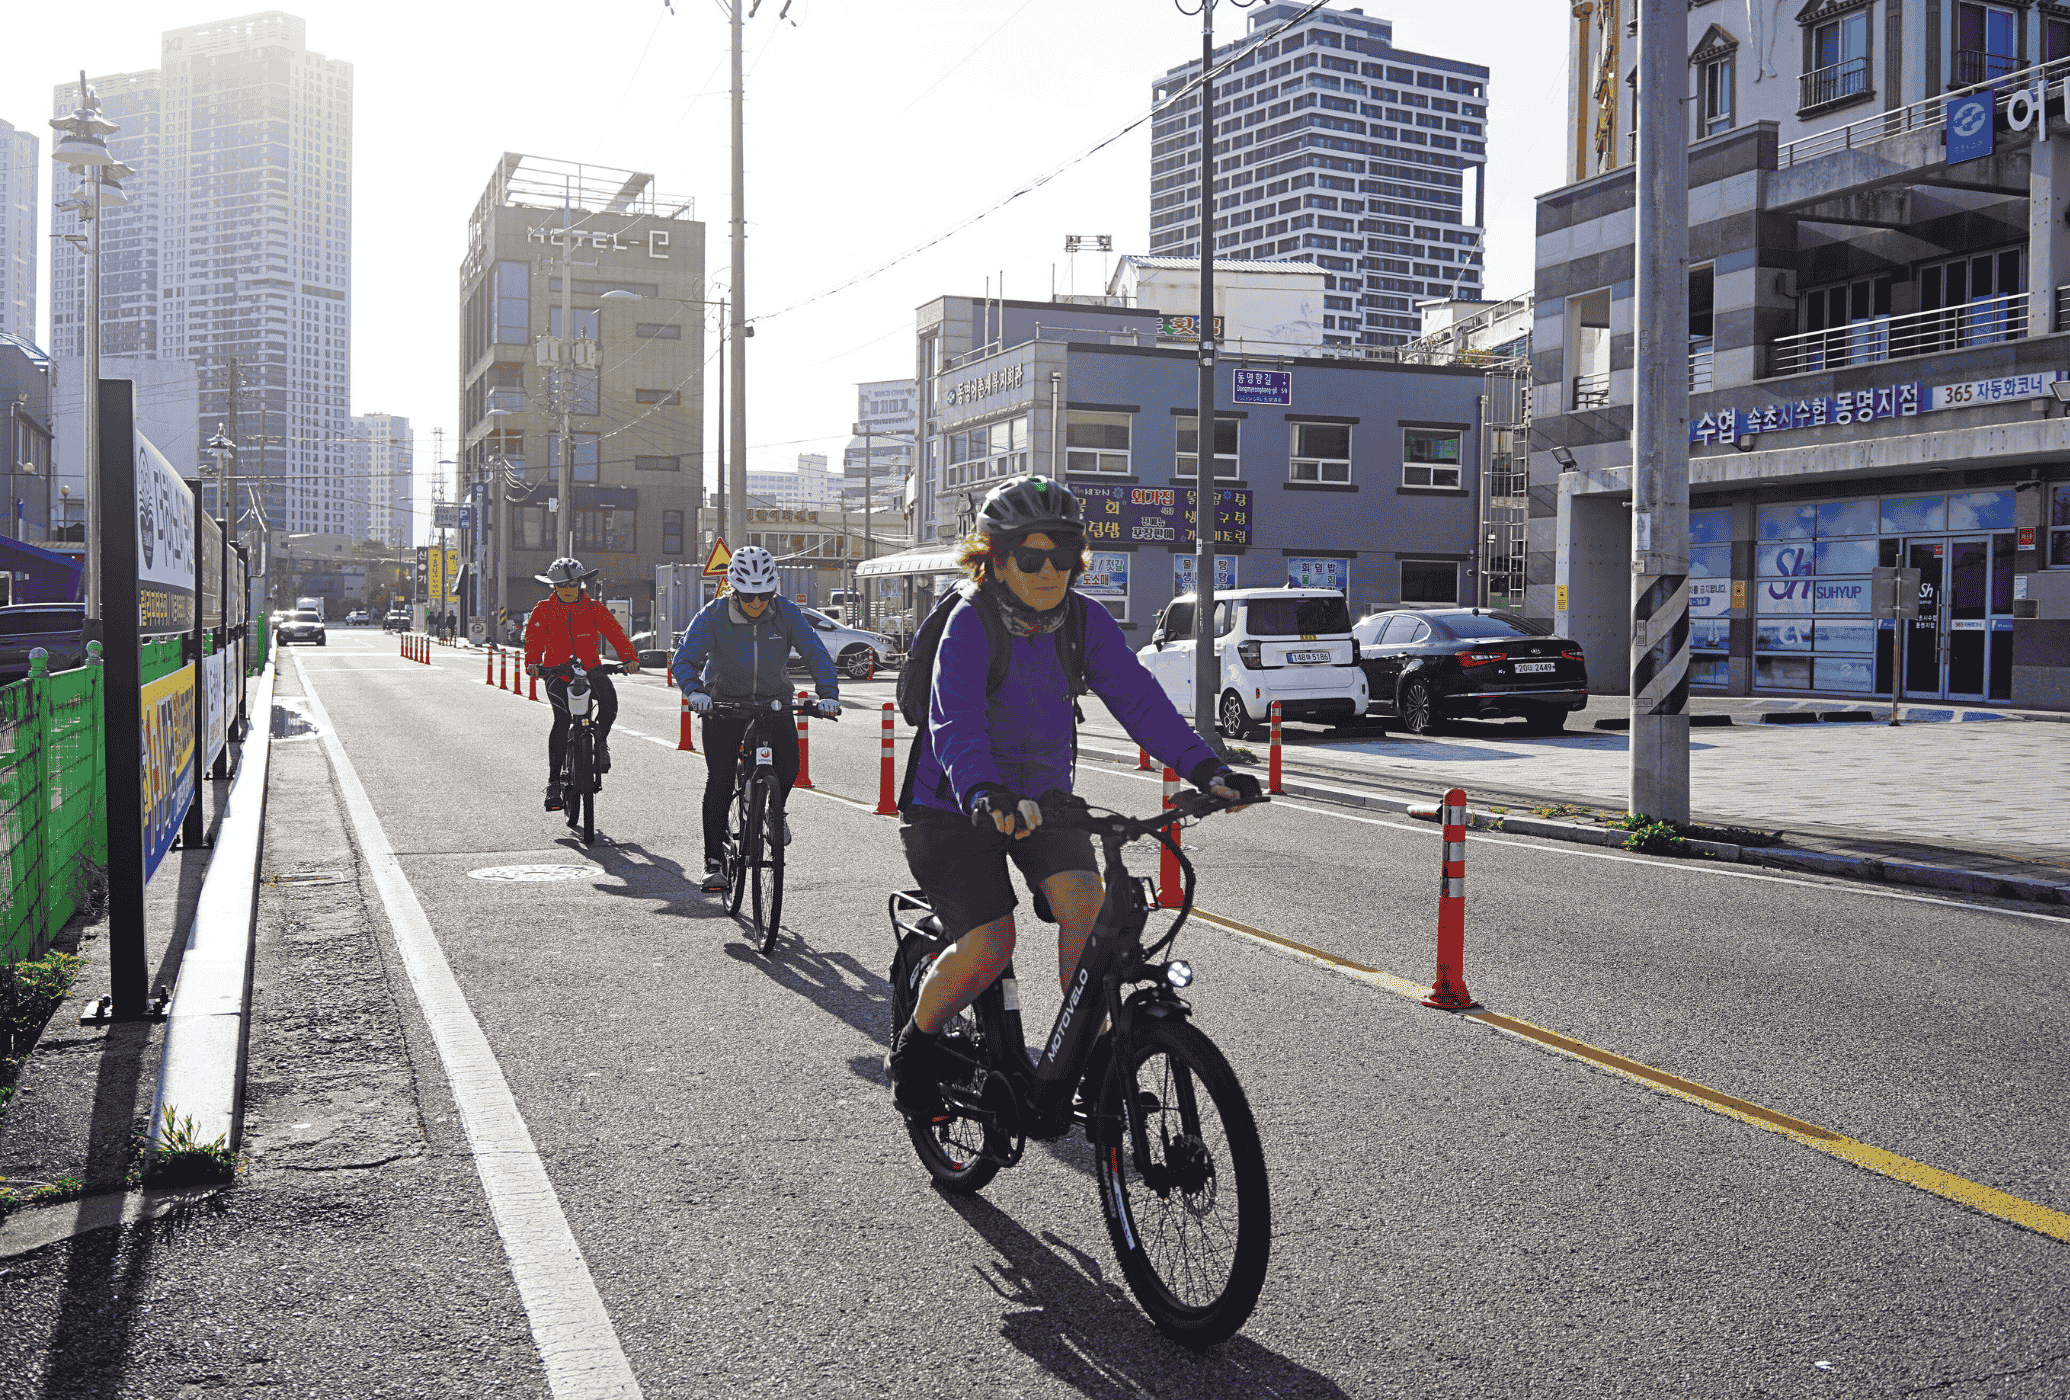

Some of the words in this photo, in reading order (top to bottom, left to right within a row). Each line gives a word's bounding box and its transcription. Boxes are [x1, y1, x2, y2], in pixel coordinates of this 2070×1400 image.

[1945, 385, 1972, 404] 365
[1977, 375, 2043, 400] 자동화코너
[1696, 408, 1738, 446] 수협
[1746, 397, 1827, 434] 속초시수협
[1835, 381, 1919, 425] 동명지점
[1768, 548, 1813, 600] Sh
[1816, 586, 1861, 599] SUHYUP
[1919, 583, 1933, 597] Sh
[1048, 968, 1088, 1063] MOTOVELO
